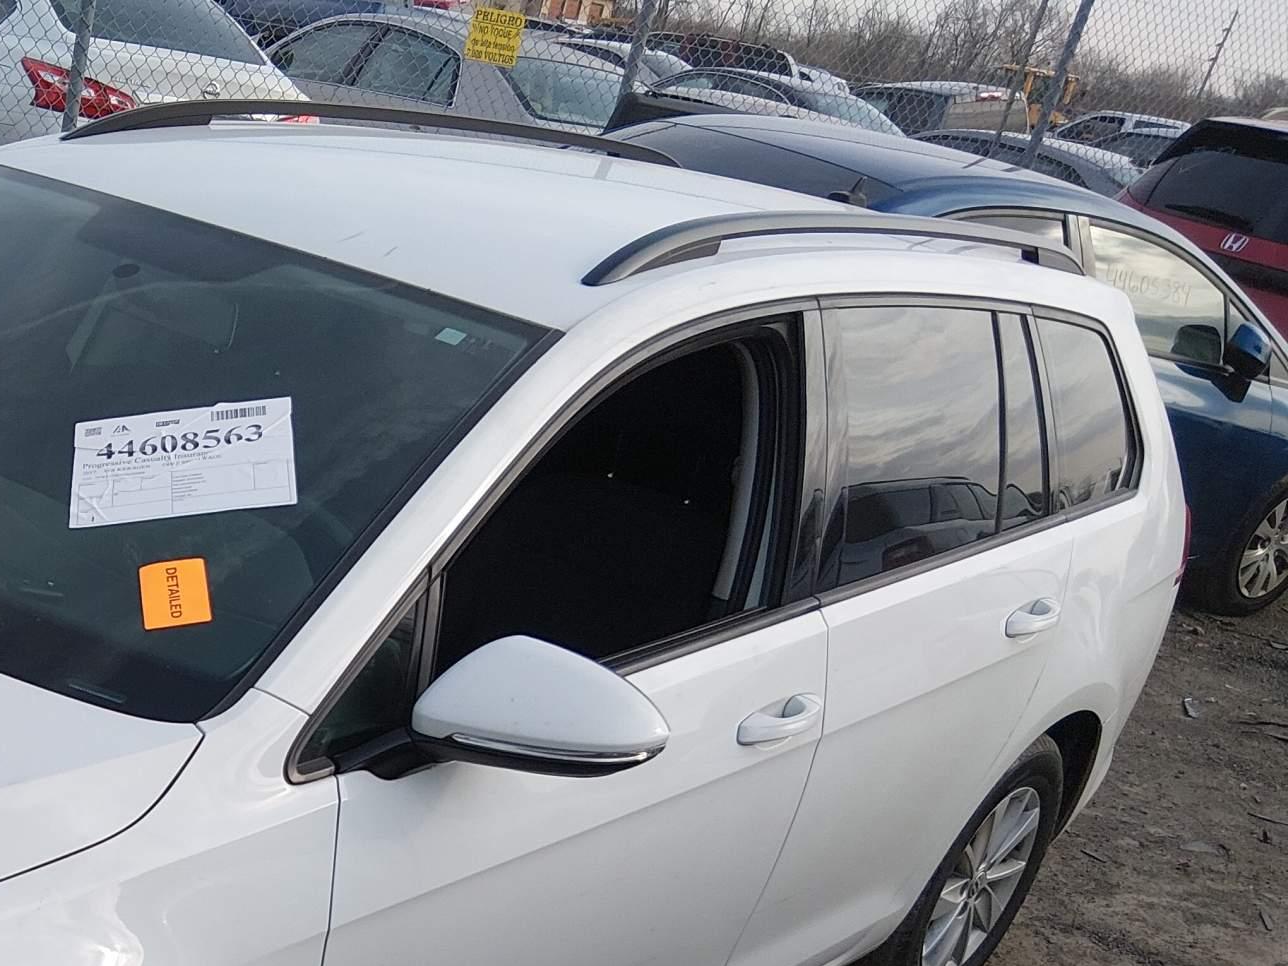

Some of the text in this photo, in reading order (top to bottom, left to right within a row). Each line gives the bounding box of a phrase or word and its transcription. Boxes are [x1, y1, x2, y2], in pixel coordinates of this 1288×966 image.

[475, 10, 523, 27] PELIGRO
[96, 424, 263, 460] 44608563
[165, 567, 182, 619] DETAILED
